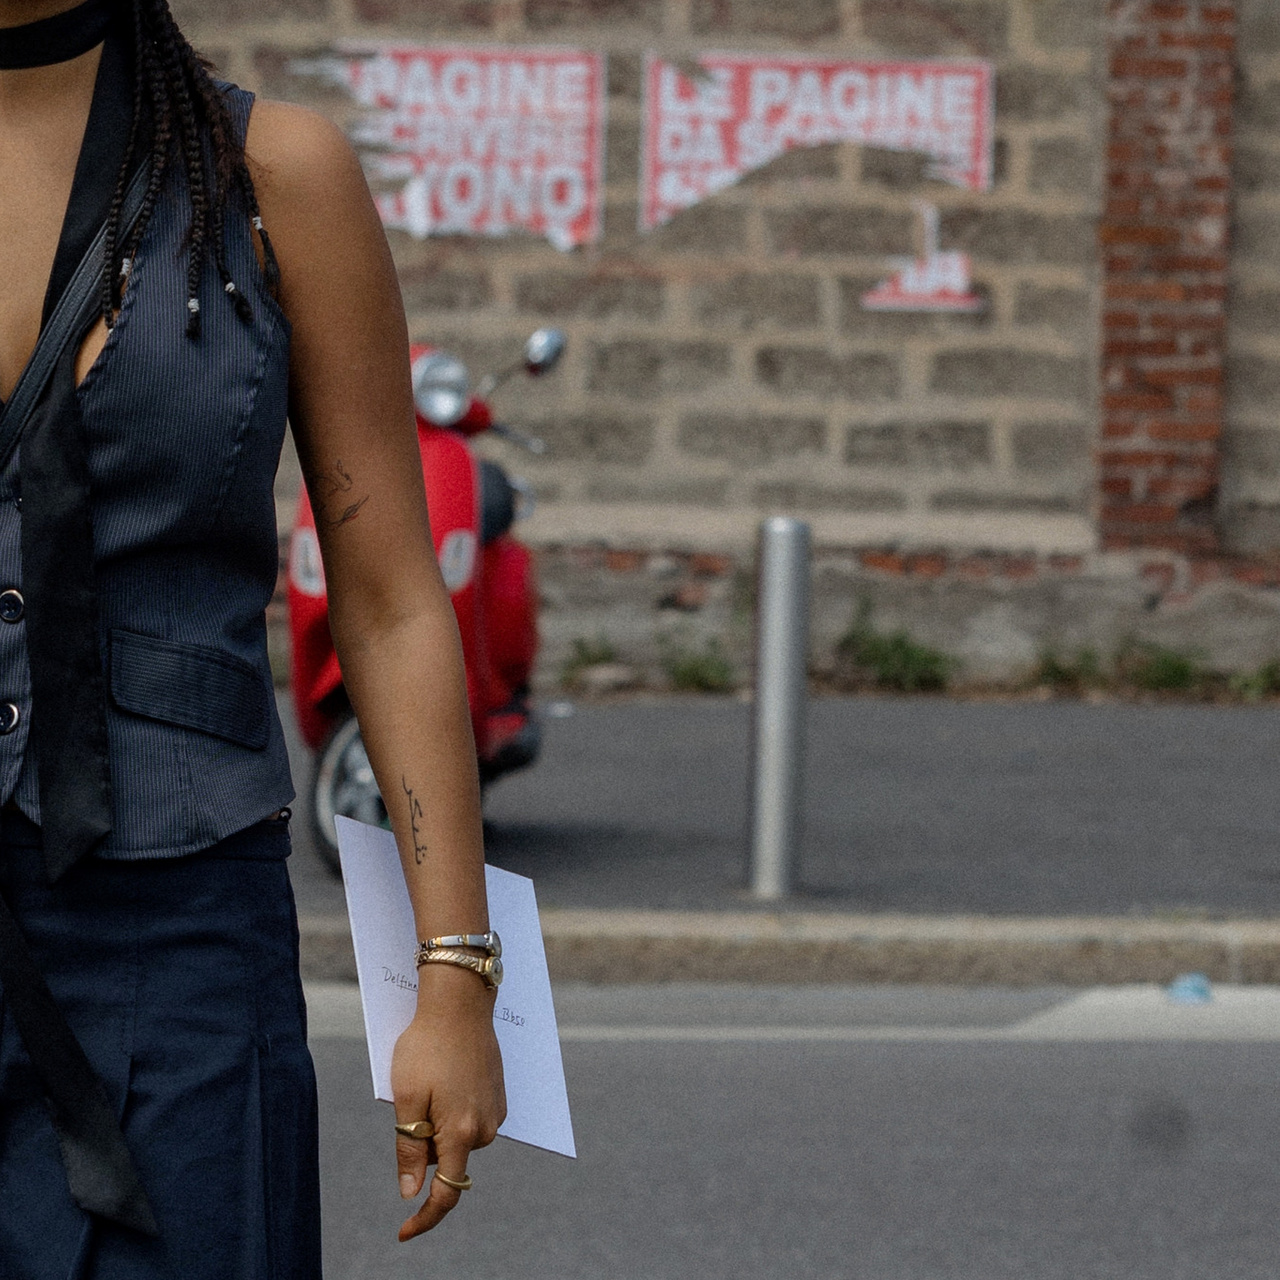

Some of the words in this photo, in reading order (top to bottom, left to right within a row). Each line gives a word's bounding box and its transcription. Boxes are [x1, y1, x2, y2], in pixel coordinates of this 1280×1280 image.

[660, 68, 734, 119] LE
[748, 69, 976, 124] PAGINE
[658, 122, 726, 163] DA
